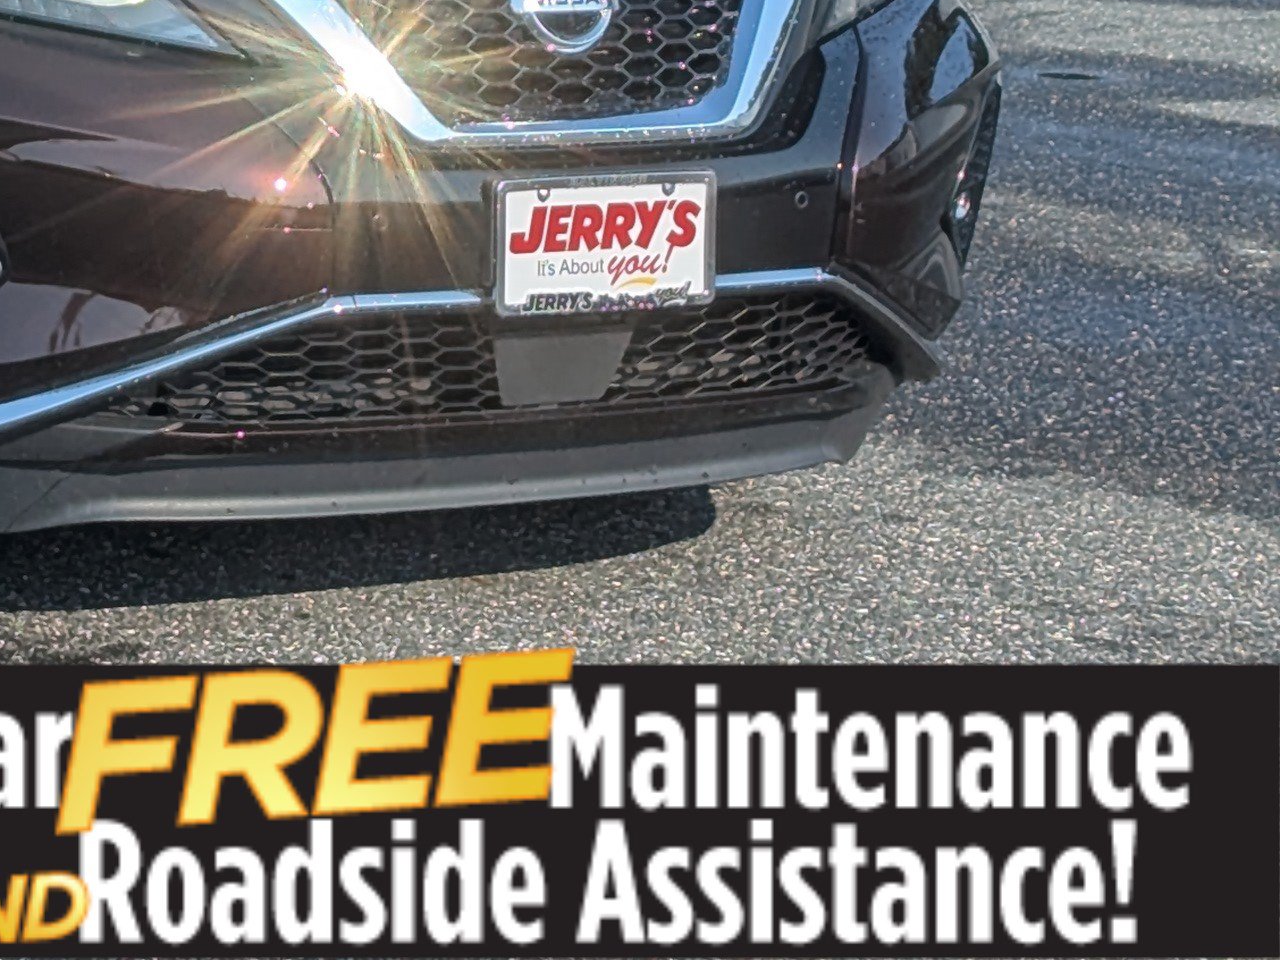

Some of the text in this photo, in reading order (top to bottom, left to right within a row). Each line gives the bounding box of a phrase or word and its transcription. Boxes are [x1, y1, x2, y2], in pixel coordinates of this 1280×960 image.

[509, 200, 701, 254] JERRY'S
[537, 245, 674, 287] It's About you!
